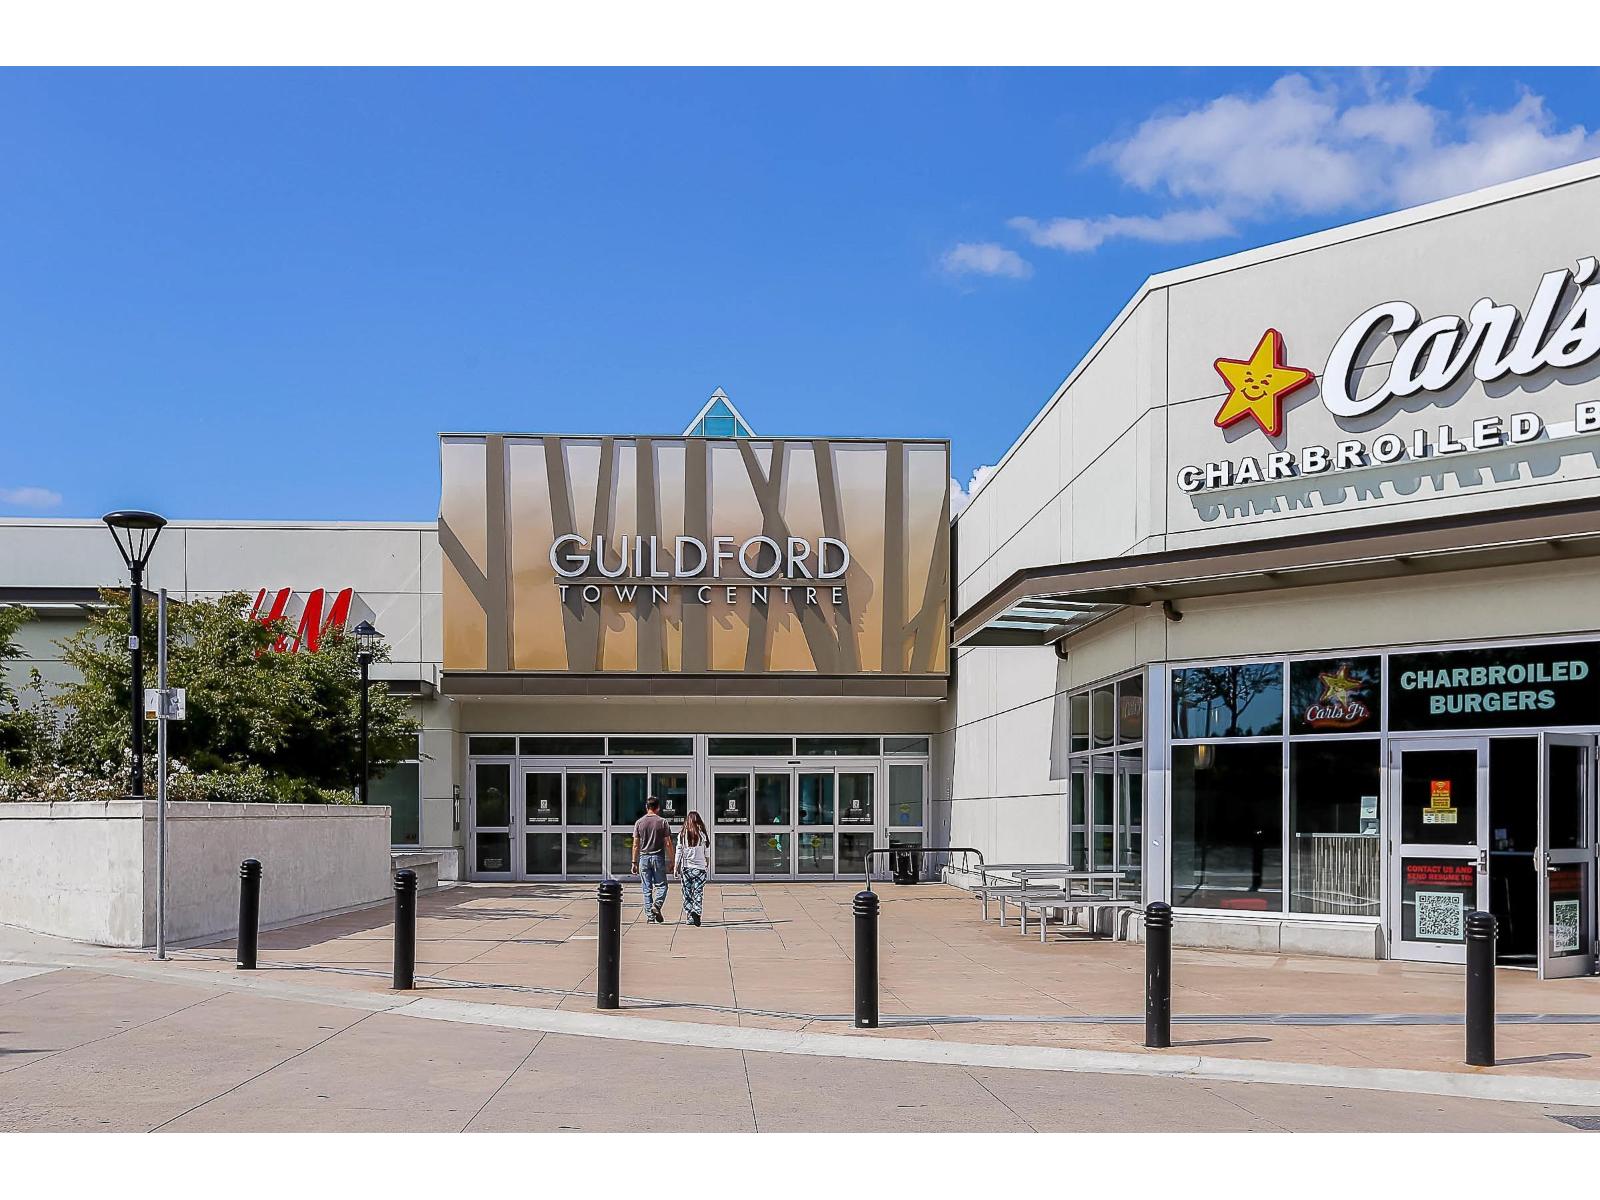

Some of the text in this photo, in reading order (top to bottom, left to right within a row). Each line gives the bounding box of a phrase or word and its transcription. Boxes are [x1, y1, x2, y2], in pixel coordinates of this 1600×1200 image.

[1321, 256, 1600, 418] Carl's
[1177, 412, 1543, 491] CHARBROILED
[550, 534, 850, 578] GUILDFORD
[559, 585, 842, 605] TOWN CENTRE
[1400, 661, 1589, 690] CHARBROILED
[1345, 701, 1369, 720] Jr.
[1430, 690, 1556, 714] BURGERS
[1407, 865, 1441, 873] CONTACT
[1428, 873, 1460, 881] RESUME
